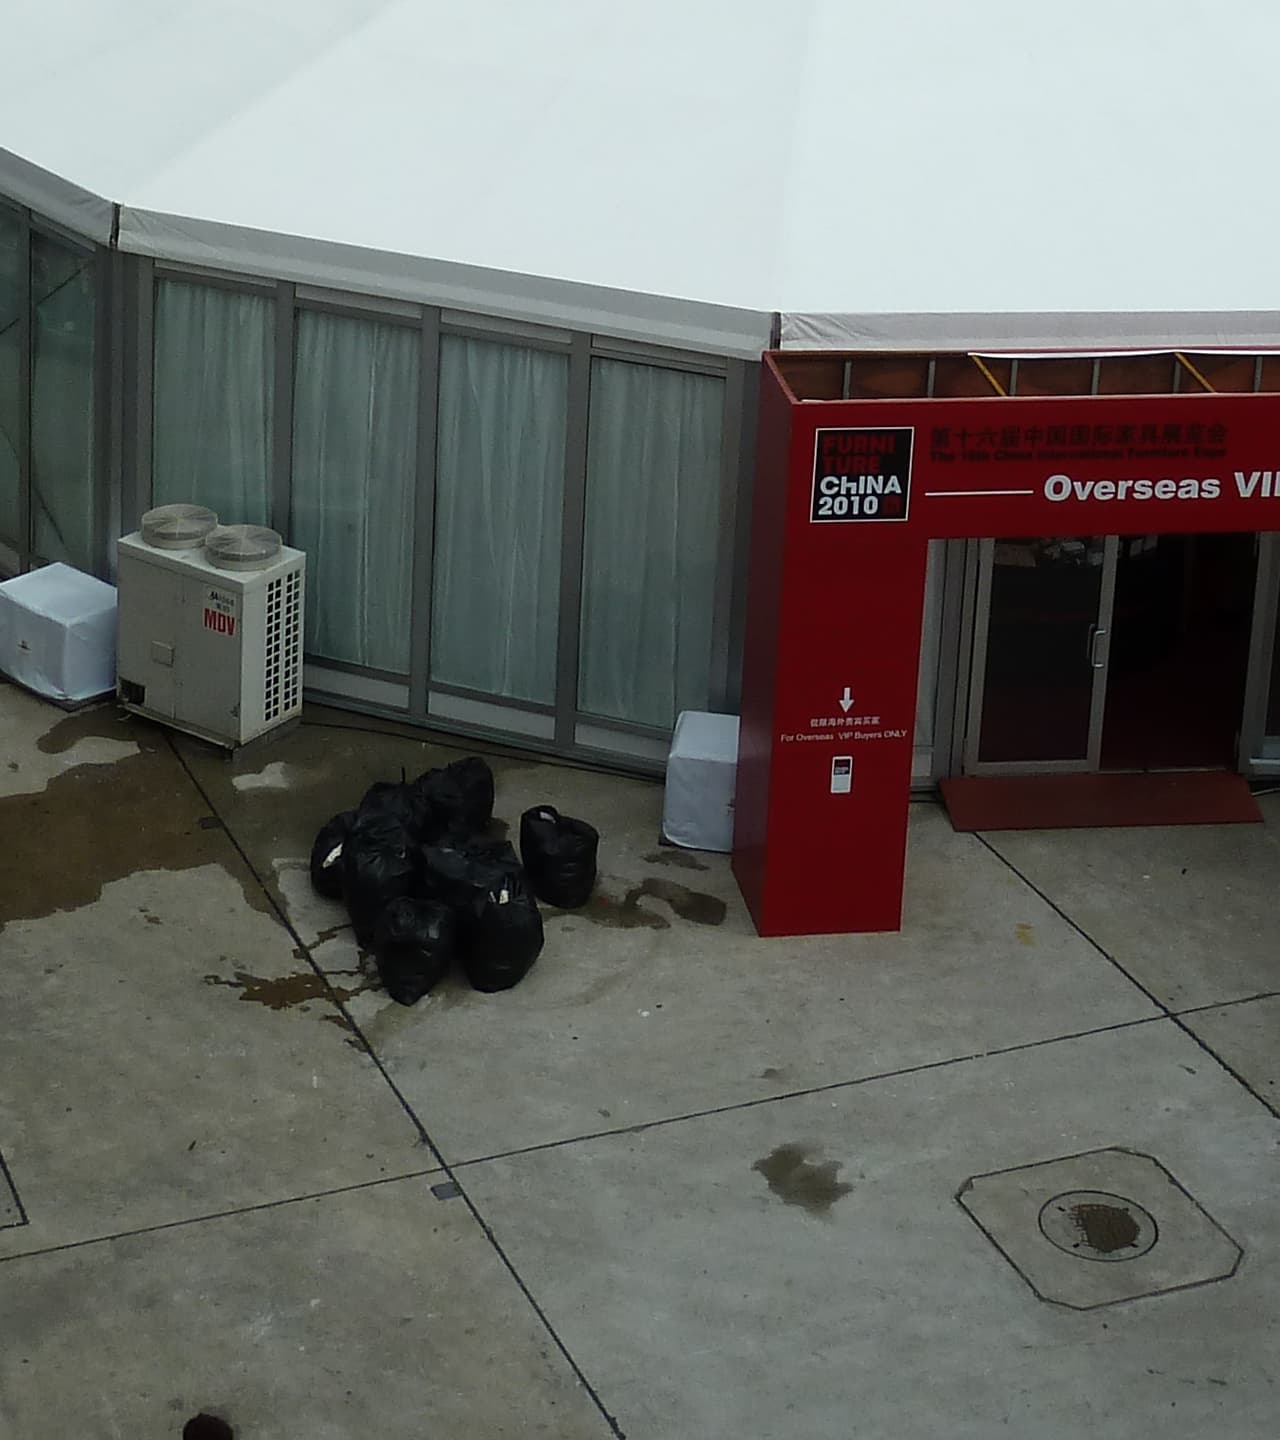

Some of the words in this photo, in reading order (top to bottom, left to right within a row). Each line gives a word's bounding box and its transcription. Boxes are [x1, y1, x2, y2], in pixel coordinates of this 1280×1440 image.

[1043, 473, 1221, 502] Overseas
[818, 495, 879, 516] 2010
[204, 607, 235, 636] MDV
[781, 734, 794, 743] For
[796, 732, 834, 742] Overseas
[838, 731, 854, 740] VIP
[854, 730, 882, 742] Buyers
[883, 729, 908, 739] ONLY
